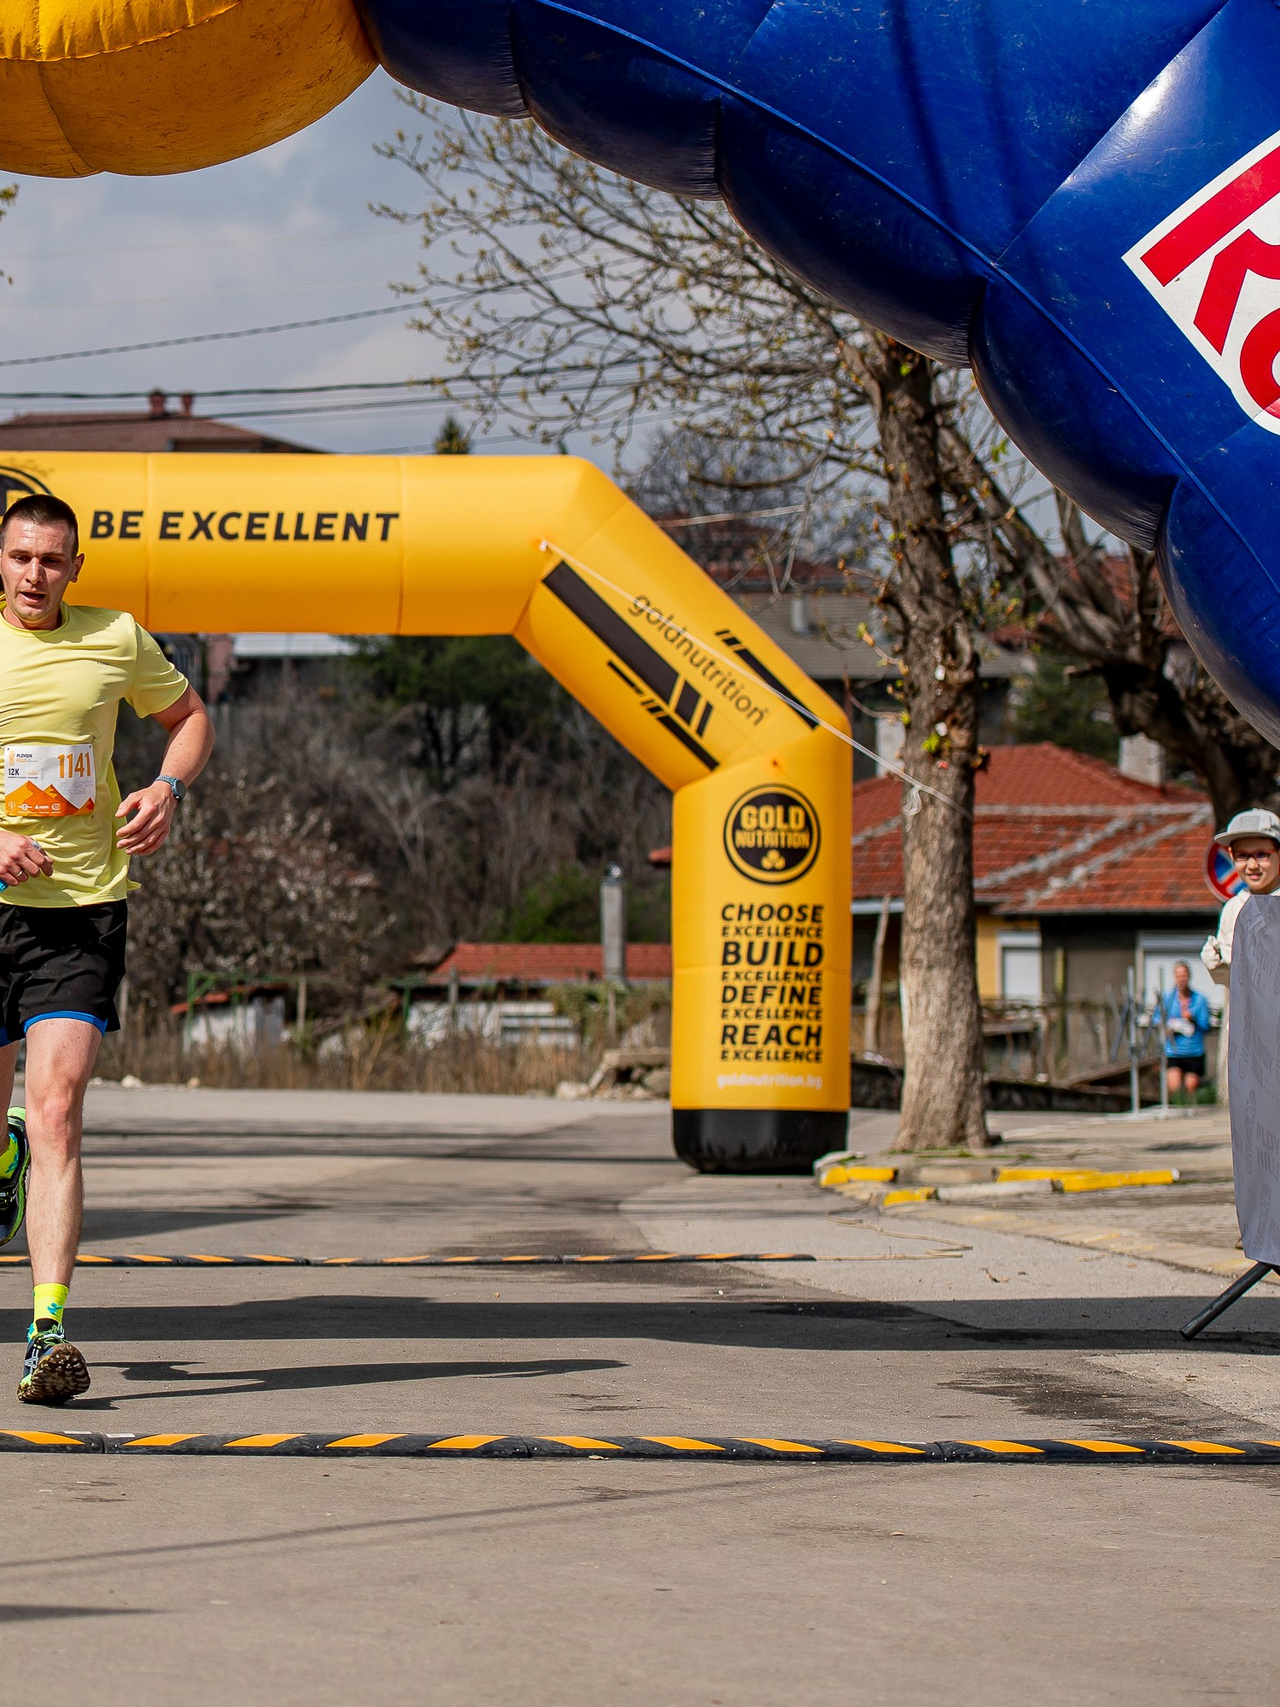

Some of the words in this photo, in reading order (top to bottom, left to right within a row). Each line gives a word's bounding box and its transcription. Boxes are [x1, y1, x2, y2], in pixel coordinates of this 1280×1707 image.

[90, 509, 144, 540] BE
[159, 510, 400, 542] EXCELLENT
[627, 594, 768, 728] goldnutrition
[8, 768, 20, 776] 12K
[57, 751, 92, 779] 1141
[740, 805, 806, 830] GOLD
[735, 829, 810, 849] NUTRITION
[721, 903, 824, 923] CHOOSE
[721, 925, 823, 939] EXCELLENCE
[721, 941, 824, 967] BUILD
[721, 970, 823, 983] EXCELLENCE
[721, 985, 823, 1005] DEFINE
[721, 1007, 823, 1021] EXCELLENCE
[721, 1024, 823, 1047] REACH
[721, 1049, 823, 1063] EXCELLENCE
[717, 1072, 824, 1090] goldnutrition.bg
